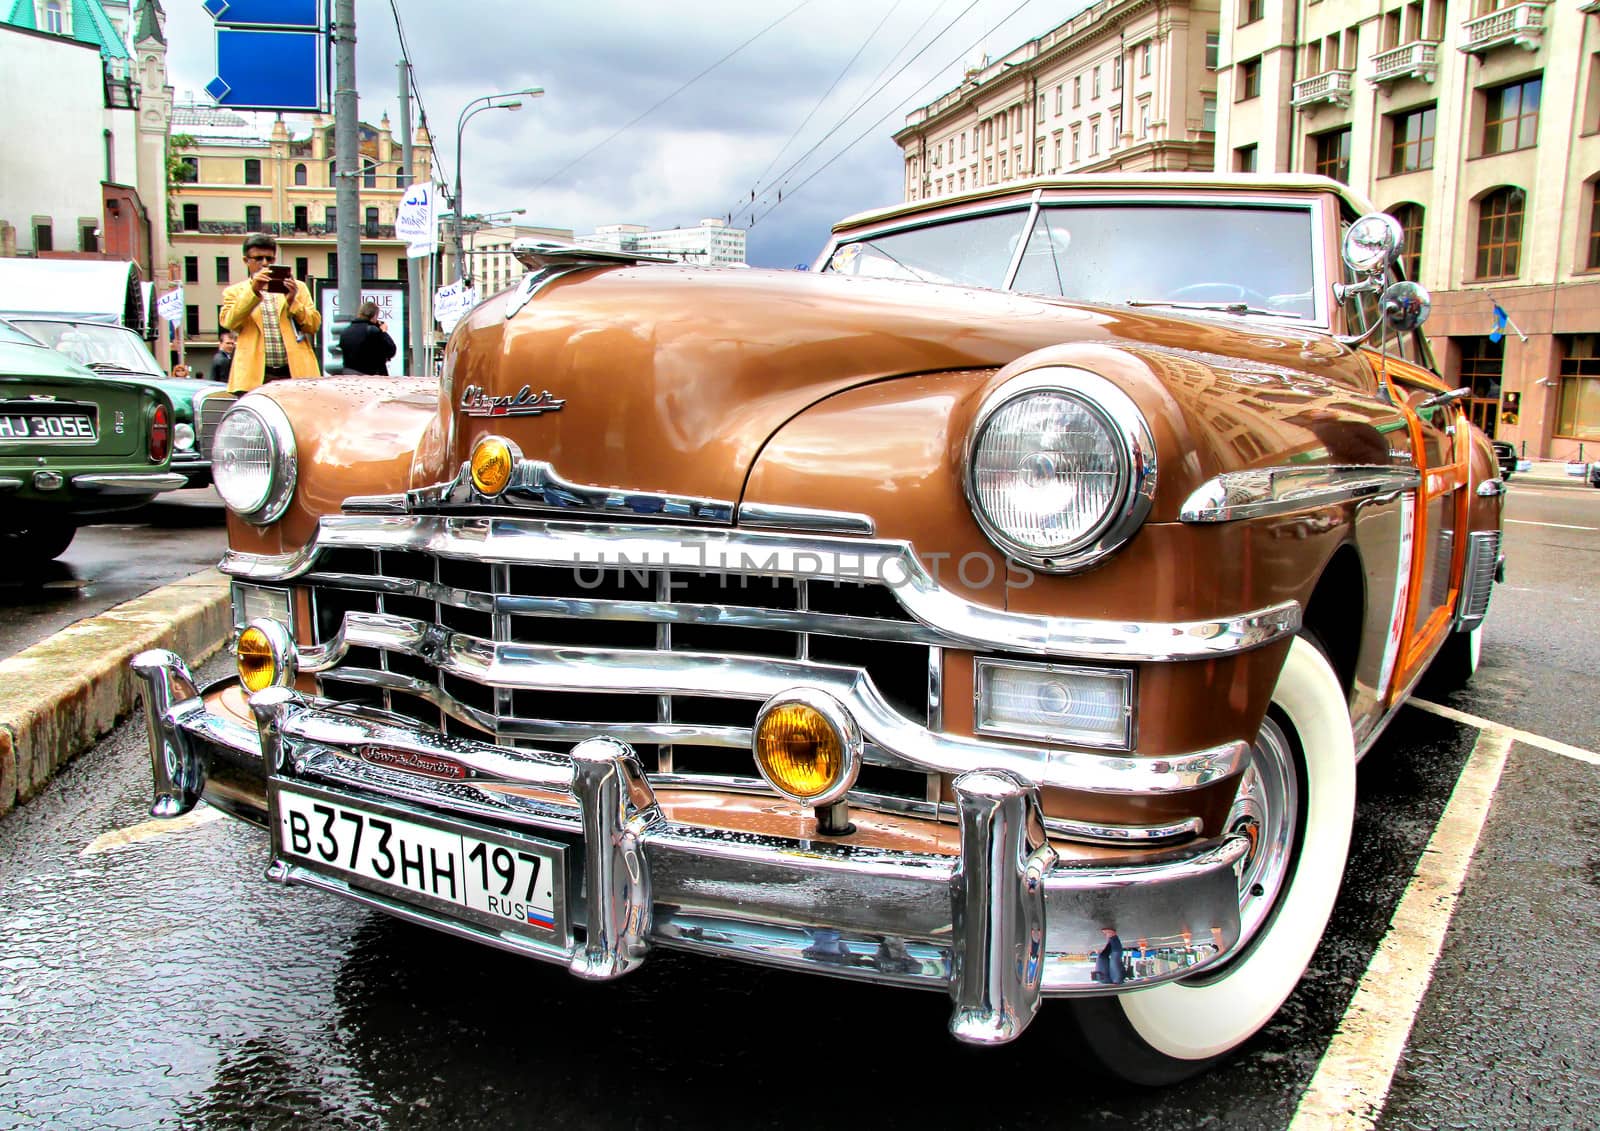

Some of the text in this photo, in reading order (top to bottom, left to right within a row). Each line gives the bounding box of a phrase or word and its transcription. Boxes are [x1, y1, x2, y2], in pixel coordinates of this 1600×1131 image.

[461, 384, 558, 413] Chrysler
[31, 416, 92, 436] 305E
[468, 842, 541, 902] 197
[488, 895, 525, 920] RUS
